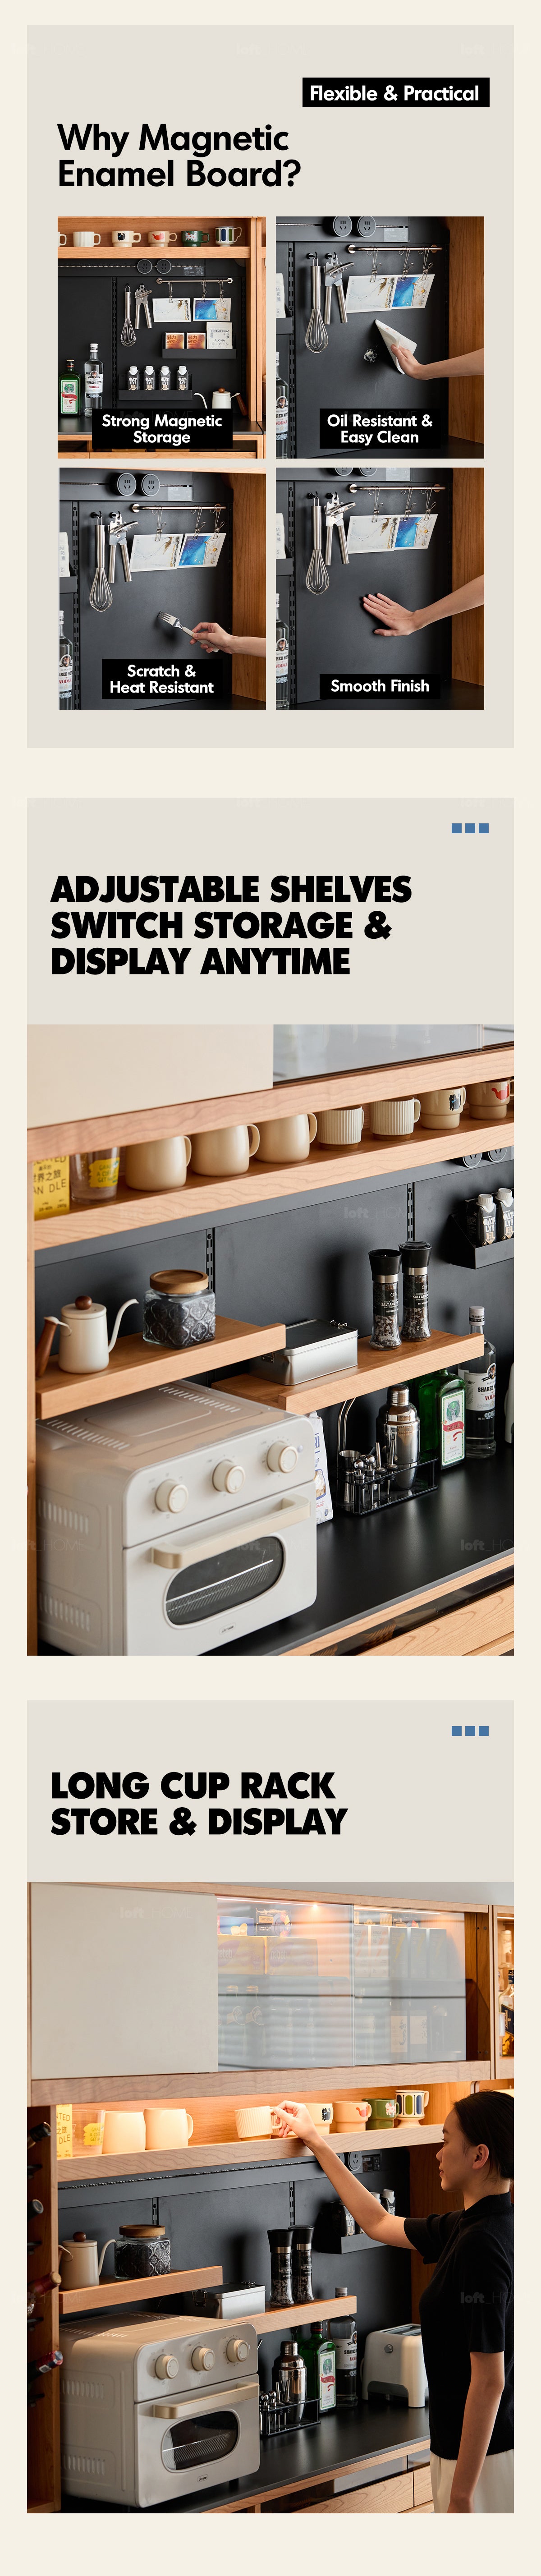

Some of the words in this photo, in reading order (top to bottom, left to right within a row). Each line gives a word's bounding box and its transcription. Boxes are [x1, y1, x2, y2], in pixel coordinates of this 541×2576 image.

[505, 1219, 513, 1227] LY!
[486, 1225, 495, 1233] LY!
[270, 1950, 287, 1959] nabati
[59, 2135, 70, 2144] DLE
